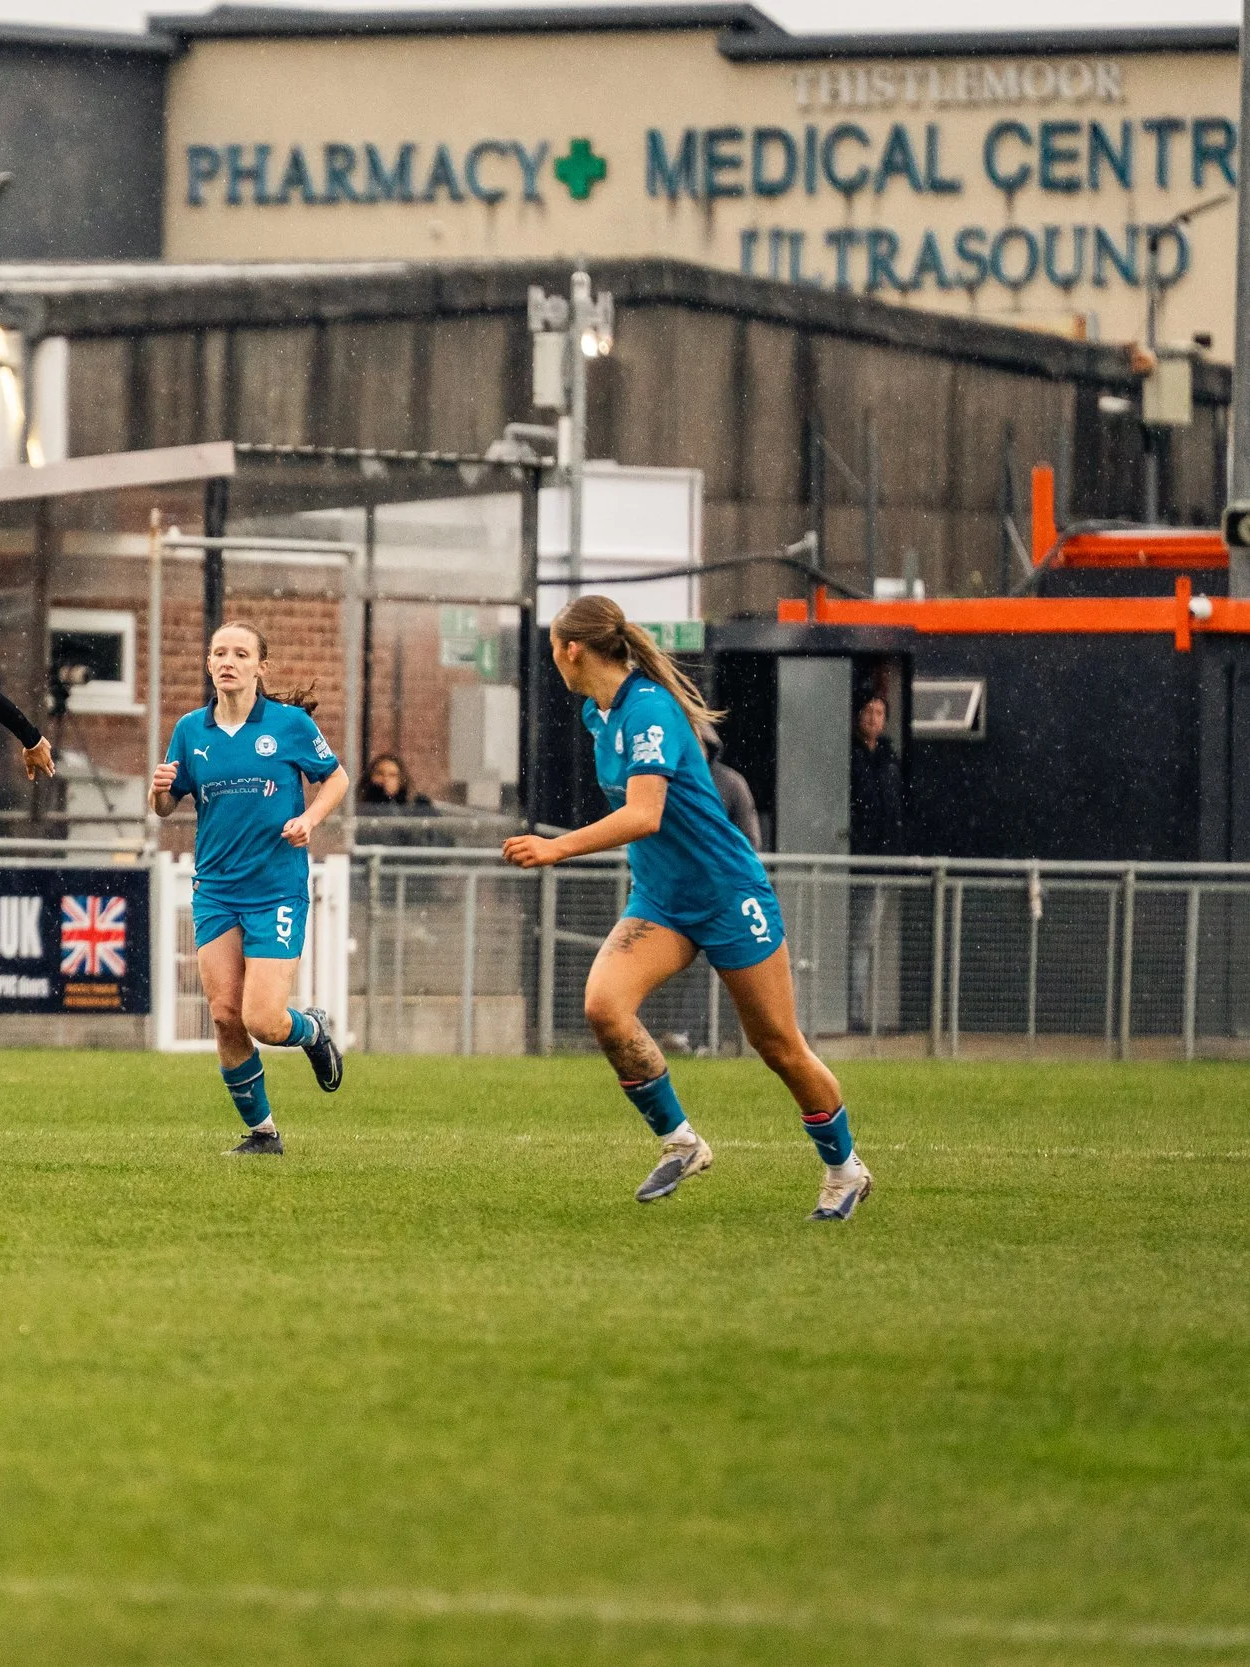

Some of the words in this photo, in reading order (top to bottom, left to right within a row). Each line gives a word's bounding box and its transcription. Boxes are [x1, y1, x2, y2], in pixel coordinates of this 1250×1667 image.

[793, 60, 1124, 106] THISTLEMOOR
[185, 139, 549, 206] PHARMACY
[644, 121, 964, 198] MEDICAL
[738, 221, 1192, 292] ULTRASOUND
[201, 780, 227, 790] NEXT
[230, 777, 267, 786] LEVEL
[276, 905, 293, 938] 5
[741, 897, 768, 936] 3
